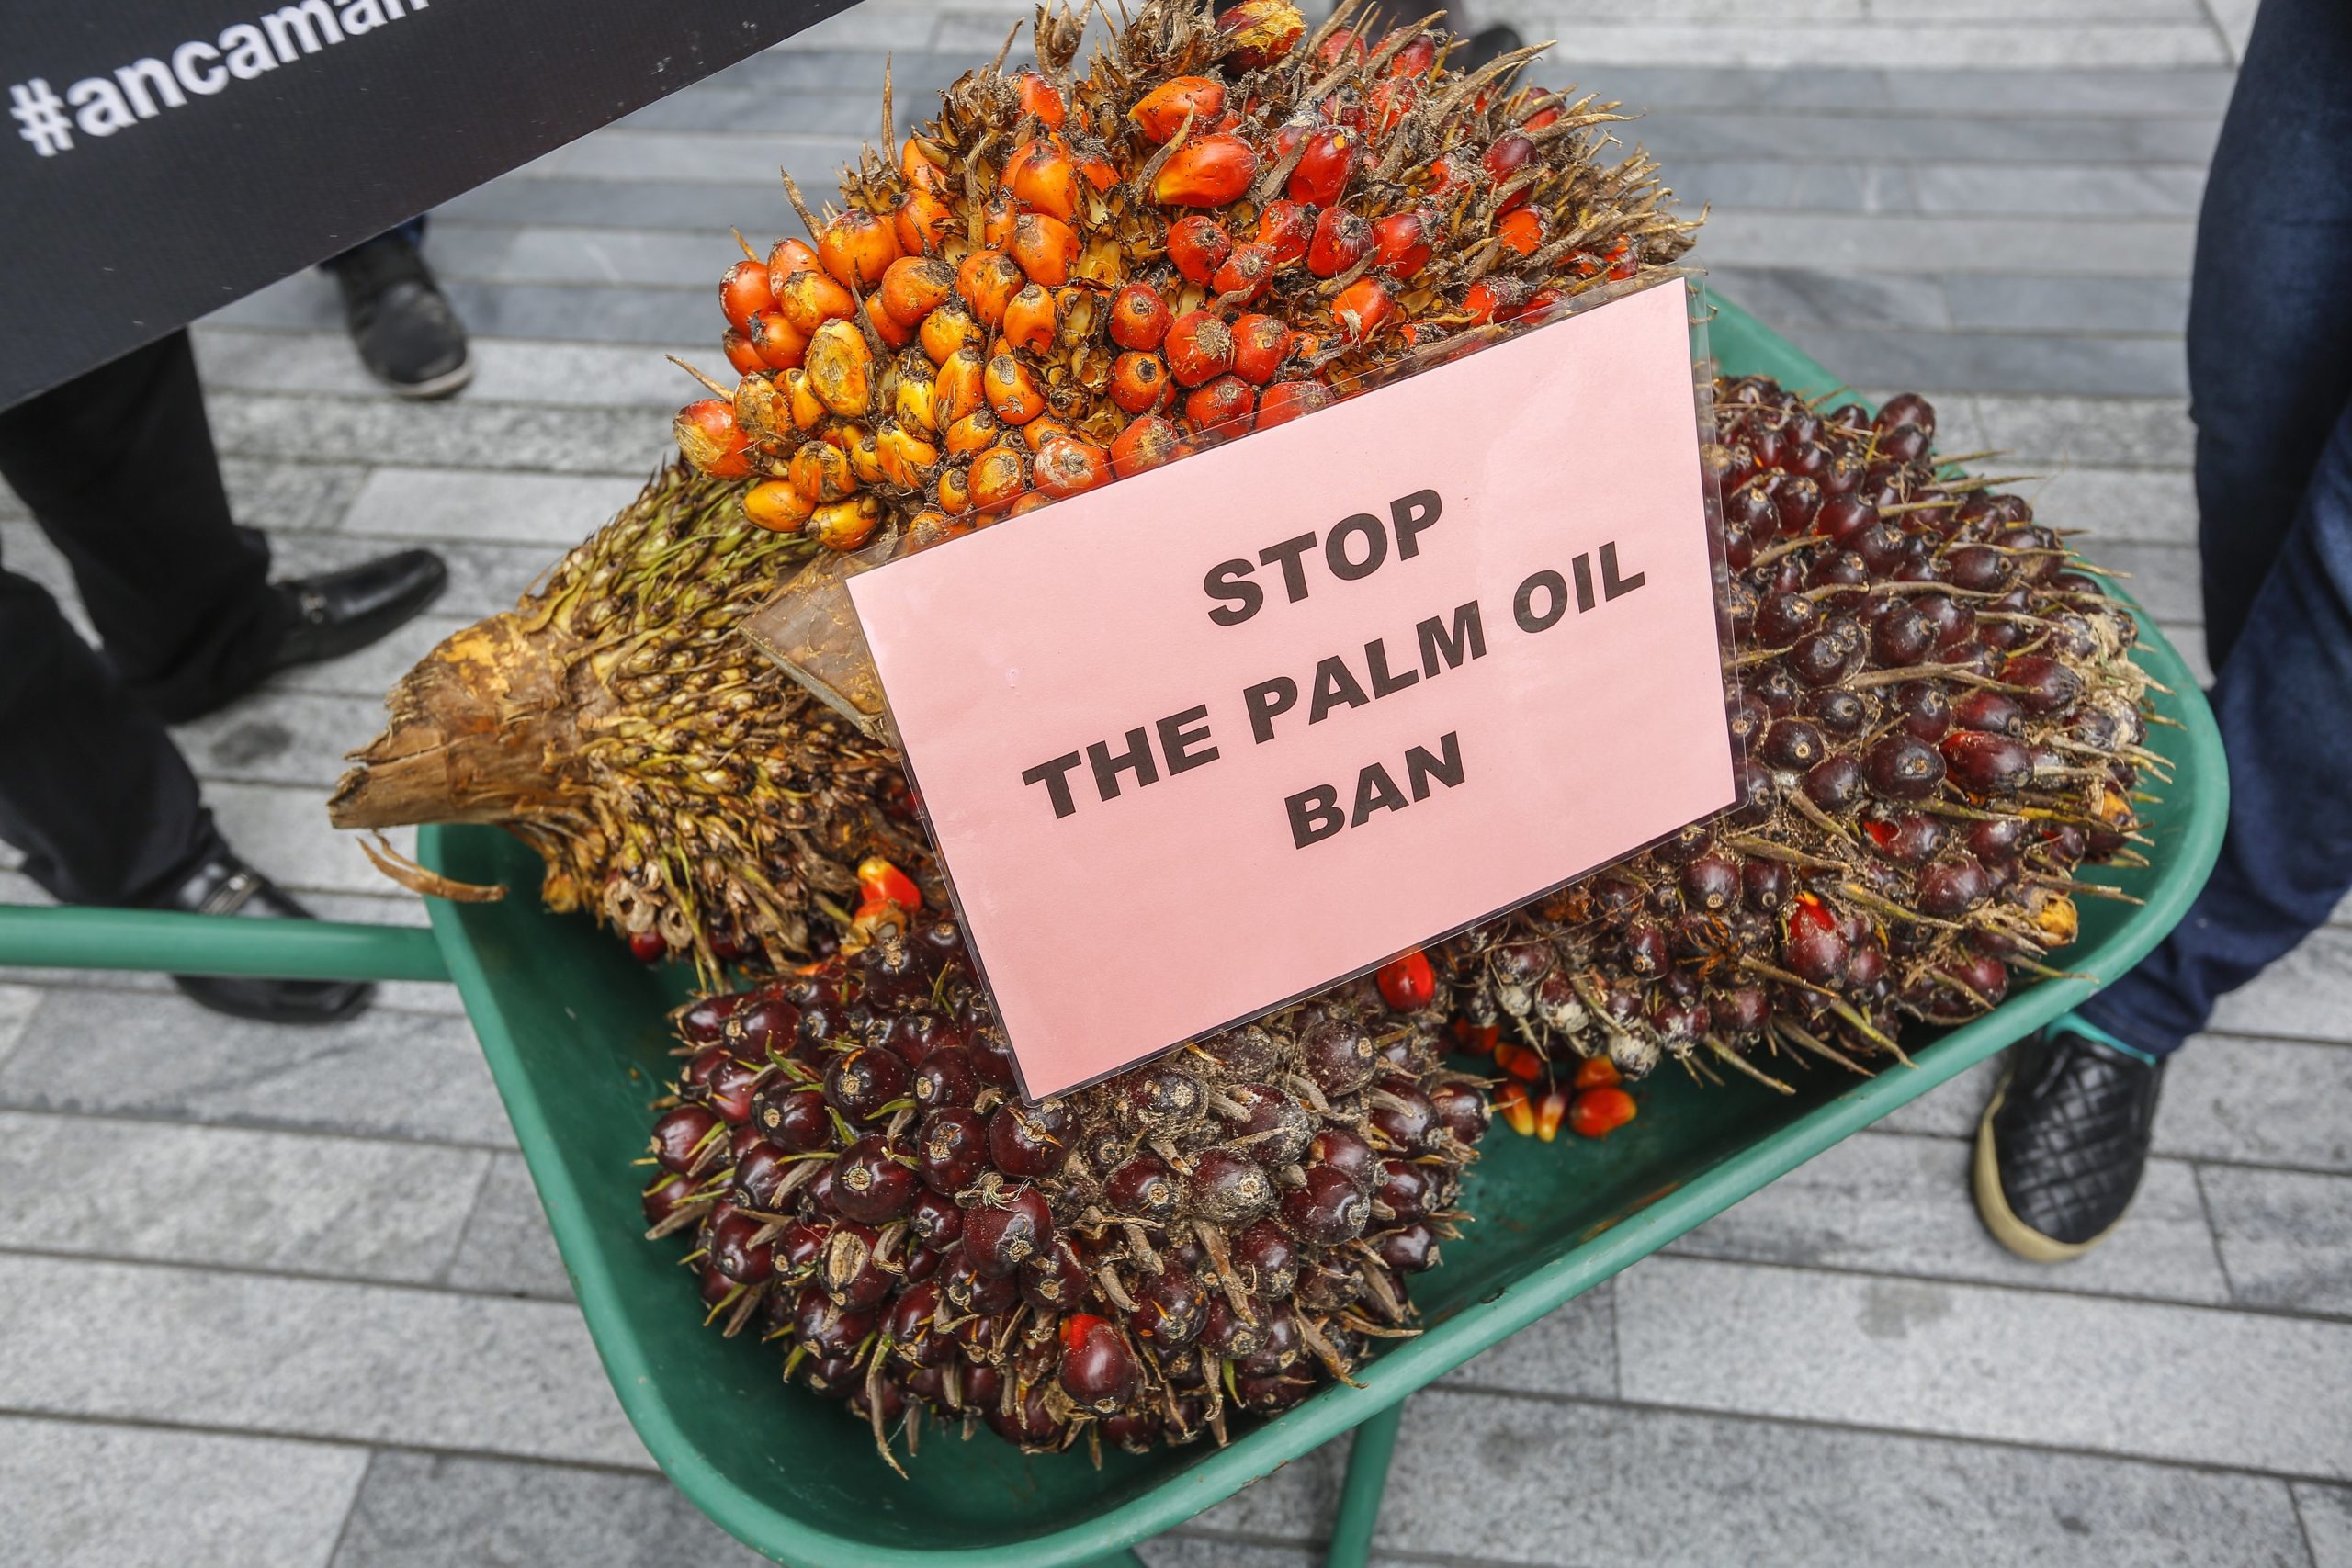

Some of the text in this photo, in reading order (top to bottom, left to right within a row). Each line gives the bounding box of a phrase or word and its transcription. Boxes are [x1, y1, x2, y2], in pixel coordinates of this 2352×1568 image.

[1203, 489, 1442, 626] STOP
[1021, 540, 1646, 820] THE PALM OIL
[1283, 730, 1465, 851] BAN
